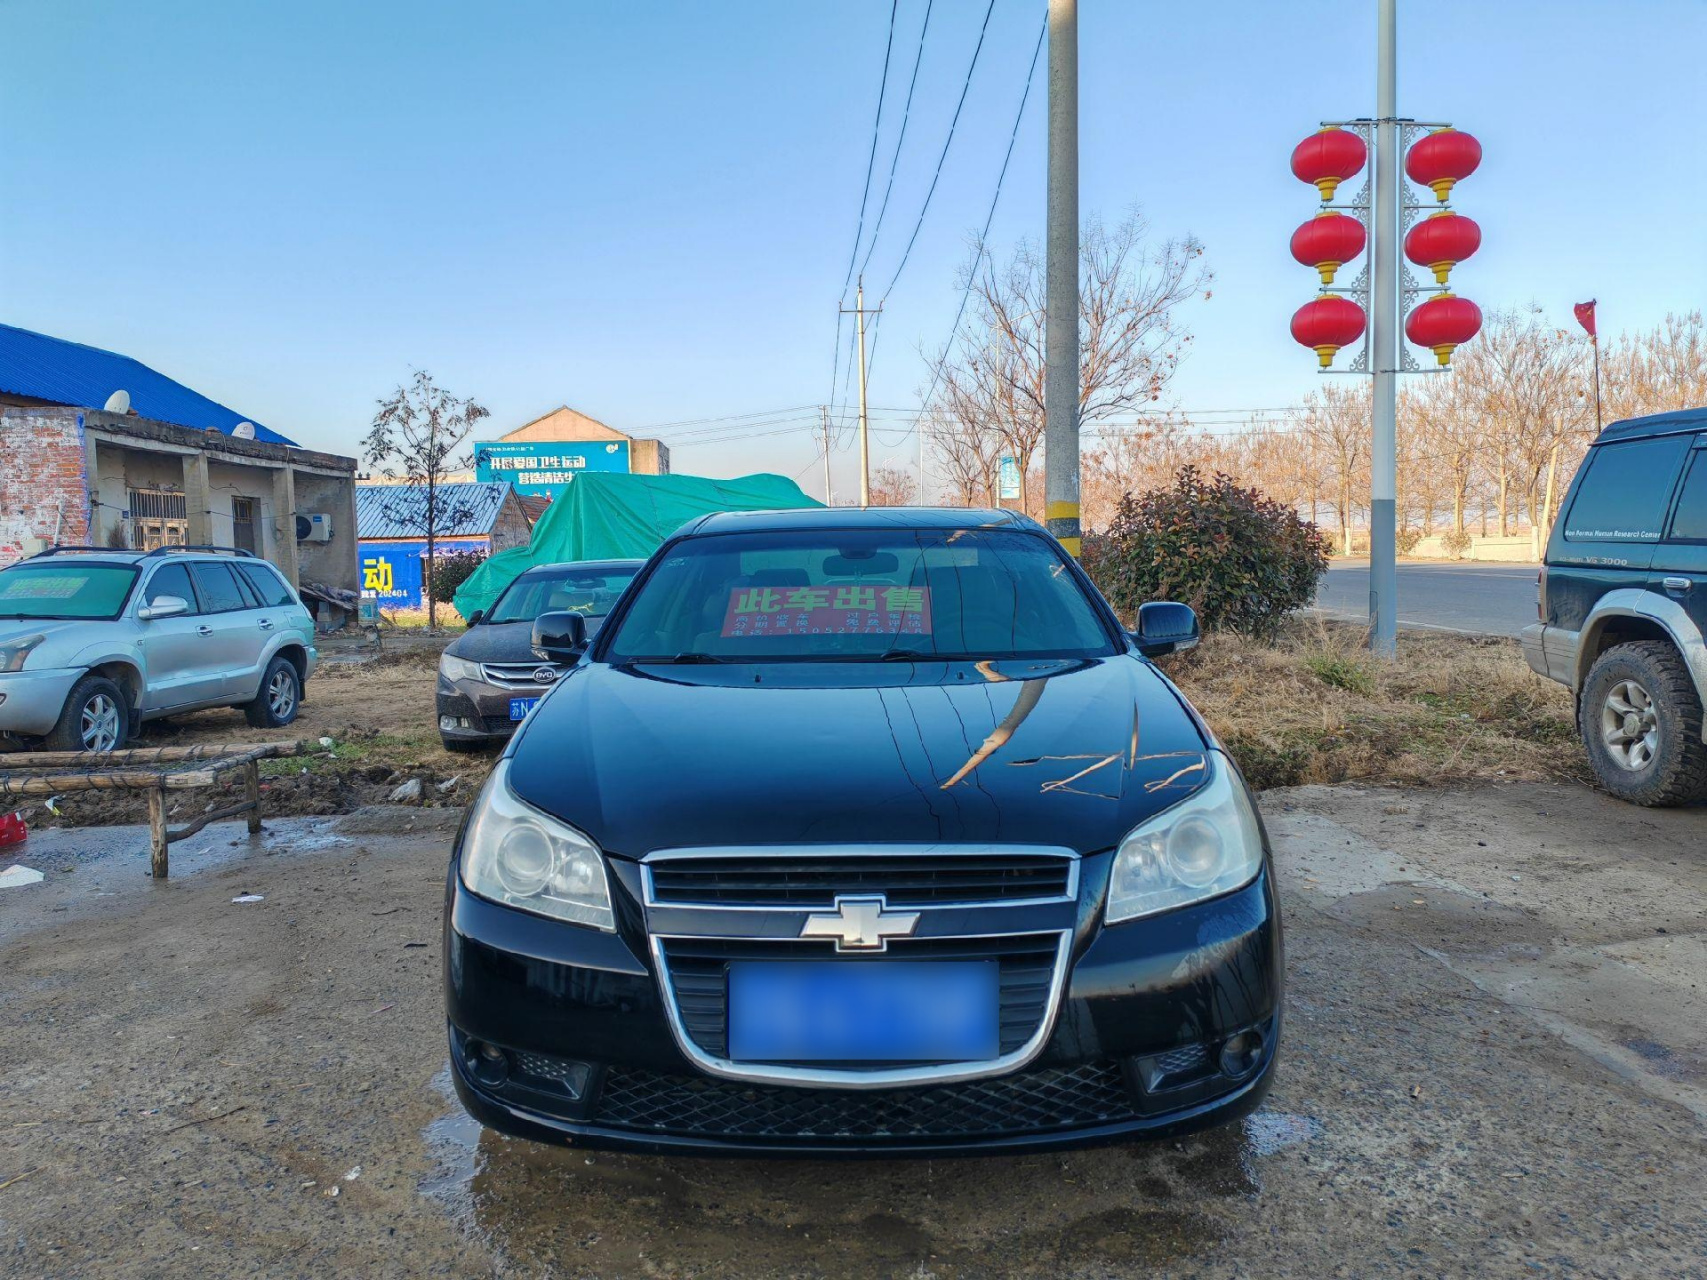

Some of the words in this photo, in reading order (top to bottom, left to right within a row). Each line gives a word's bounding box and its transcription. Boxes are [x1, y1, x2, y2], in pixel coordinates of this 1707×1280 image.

[490, 456, 586, 470] 开展爱国卫生运动
[1614, 530, 1640, 538] Research
[1601, 557, 1627, 566] 3000
[363, 556, 393, 592] 动
[734, 586, 925, 614] 此车出售
[511, 701, 538, 717] 苏N
